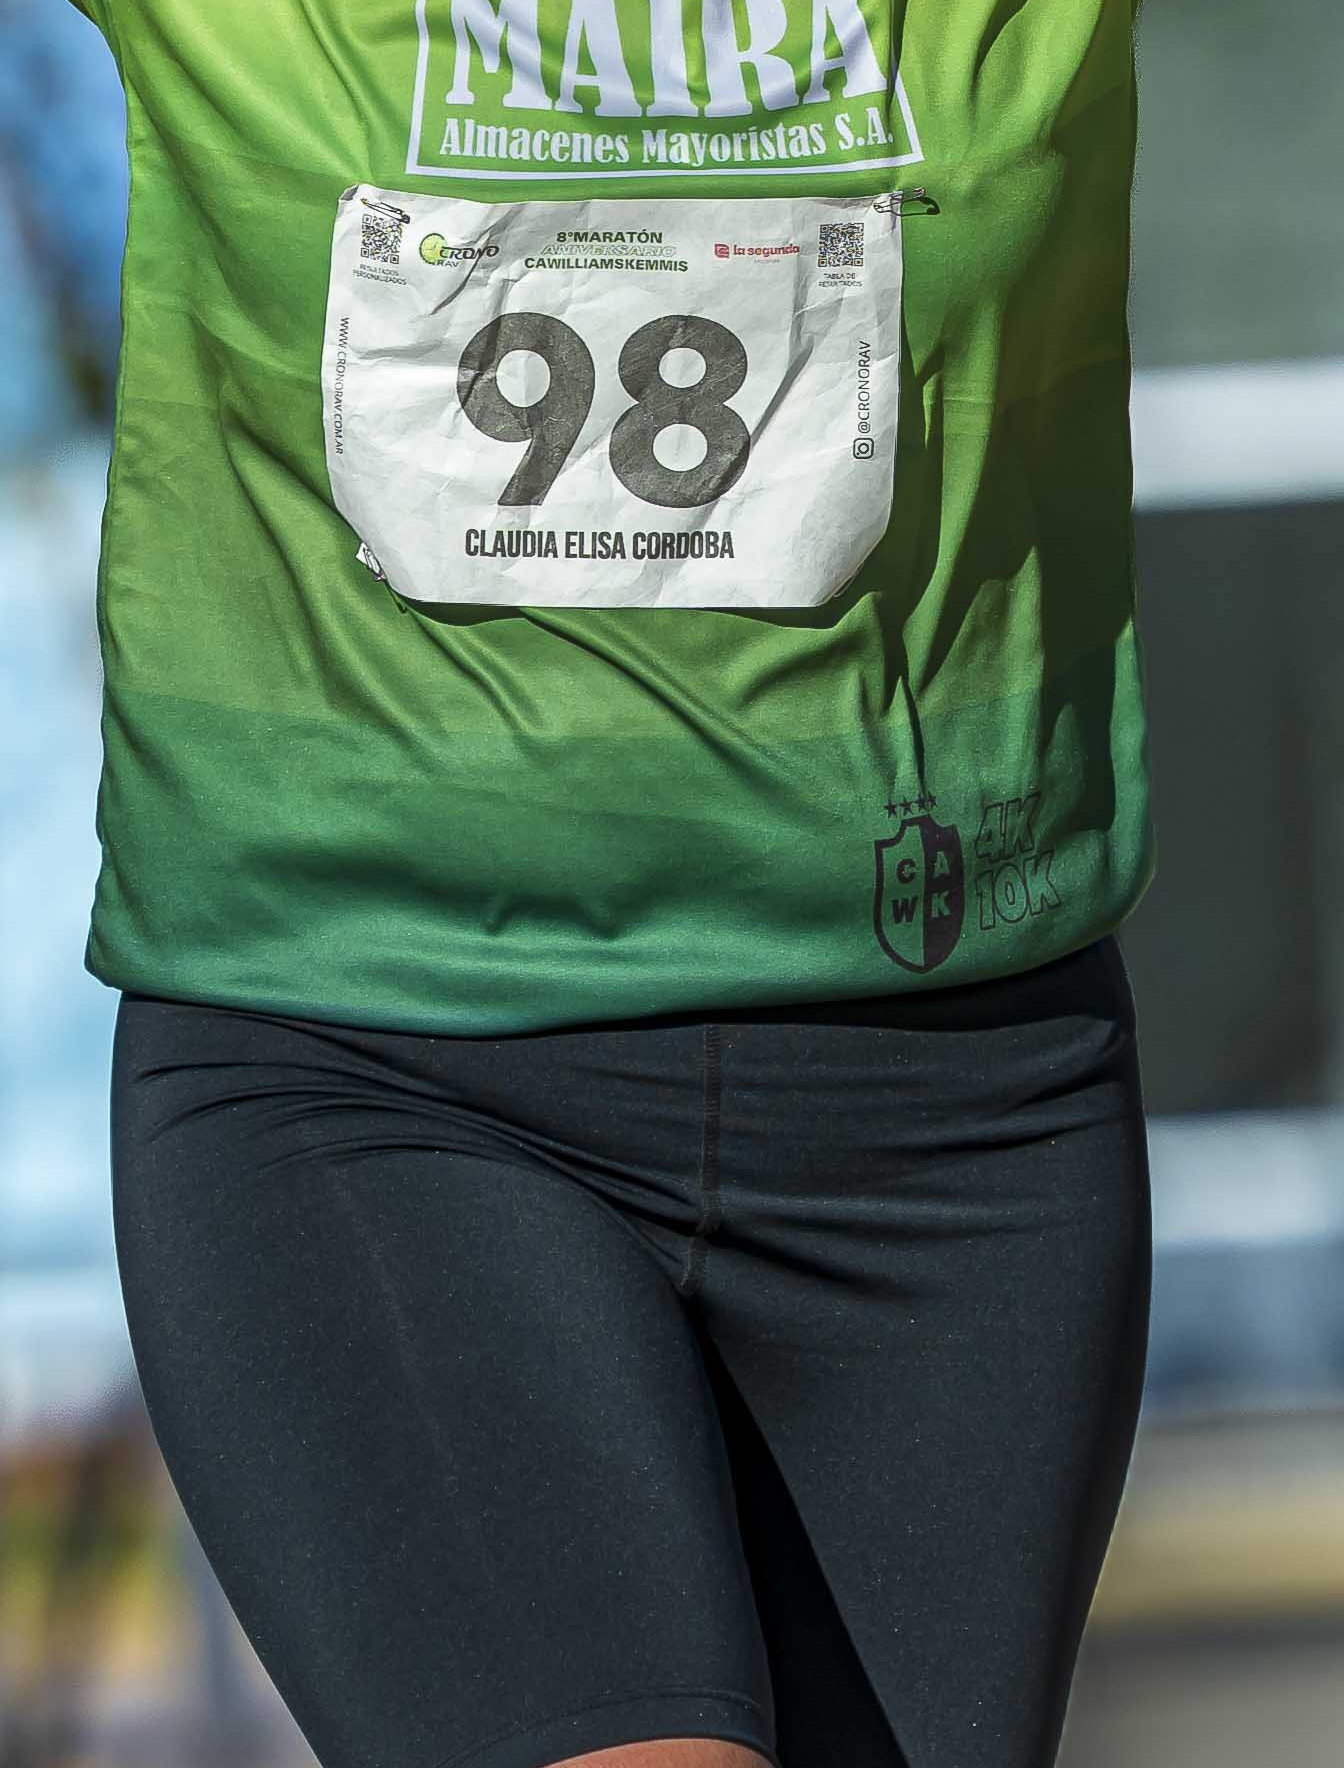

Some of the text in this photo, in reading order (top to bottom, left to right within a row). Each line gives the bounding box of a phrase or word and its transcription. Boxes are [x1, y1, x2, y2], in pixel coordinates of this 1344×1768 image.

[439, 117, 629, 164] Almacenes
[642, 120, 826, 167] Mayoristas
[439, 245, 500, 260] CRONO
[541, 244, 677, 258] ANIVERSARIO
[733, 243, 801, 258] la segunda
[524, 257, 689, 273] CAWILLIAMSKEMMIS
[858, 340, 871, 434] @CRONORAV
[457, 312, 751, 509] 98
[465, 529, 735, 560] CLAUDIA ELISA CORDOBA
